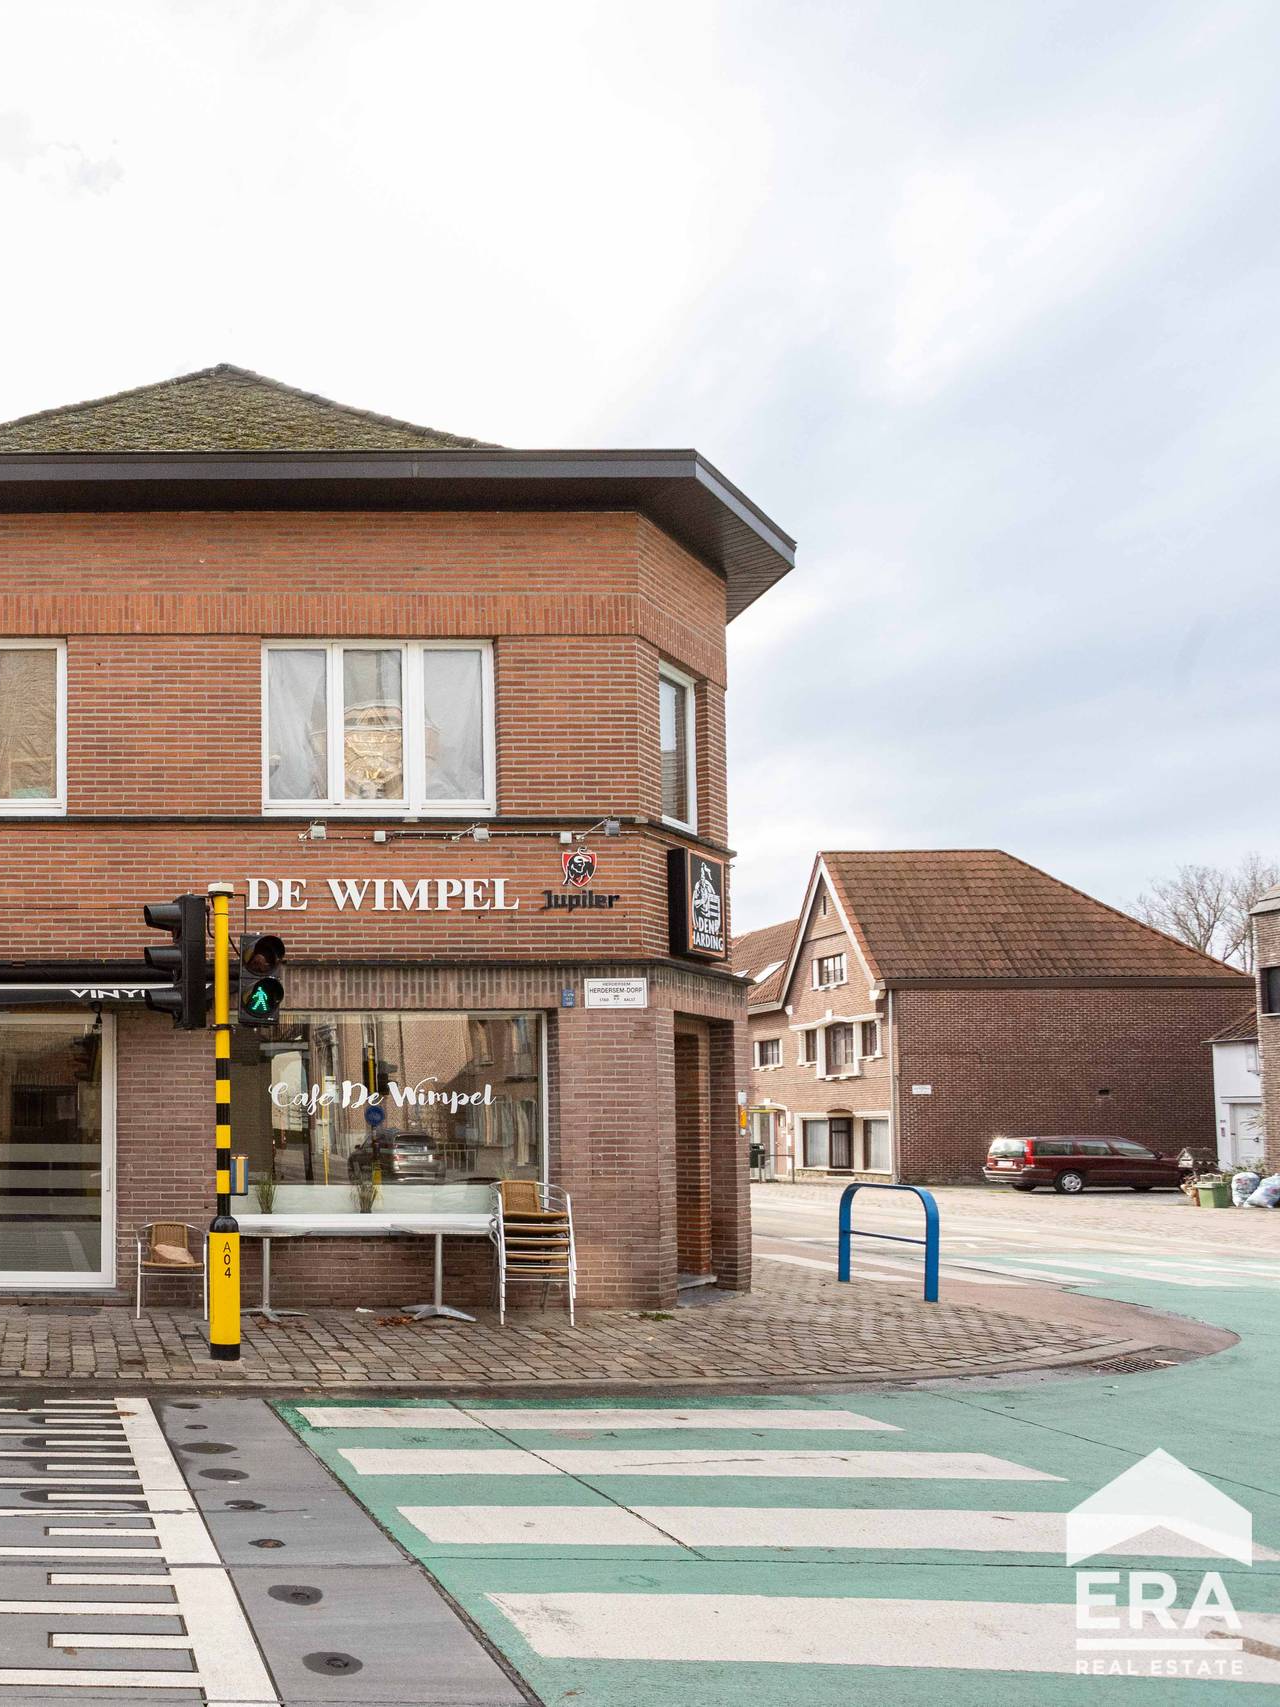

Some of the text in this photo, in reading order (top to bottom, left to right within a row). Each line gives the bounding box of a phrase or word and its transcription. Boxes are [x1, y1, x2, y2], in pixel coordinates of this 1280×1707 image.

[245, 878, 520, 911] DE WIMPEL
[539, 890, 620, 913] Jupiler
[70, 989, 146, 999] VINY
[342, 1080, 384, 1109] De
[387, 1077, 497, 1114] Wimpel
